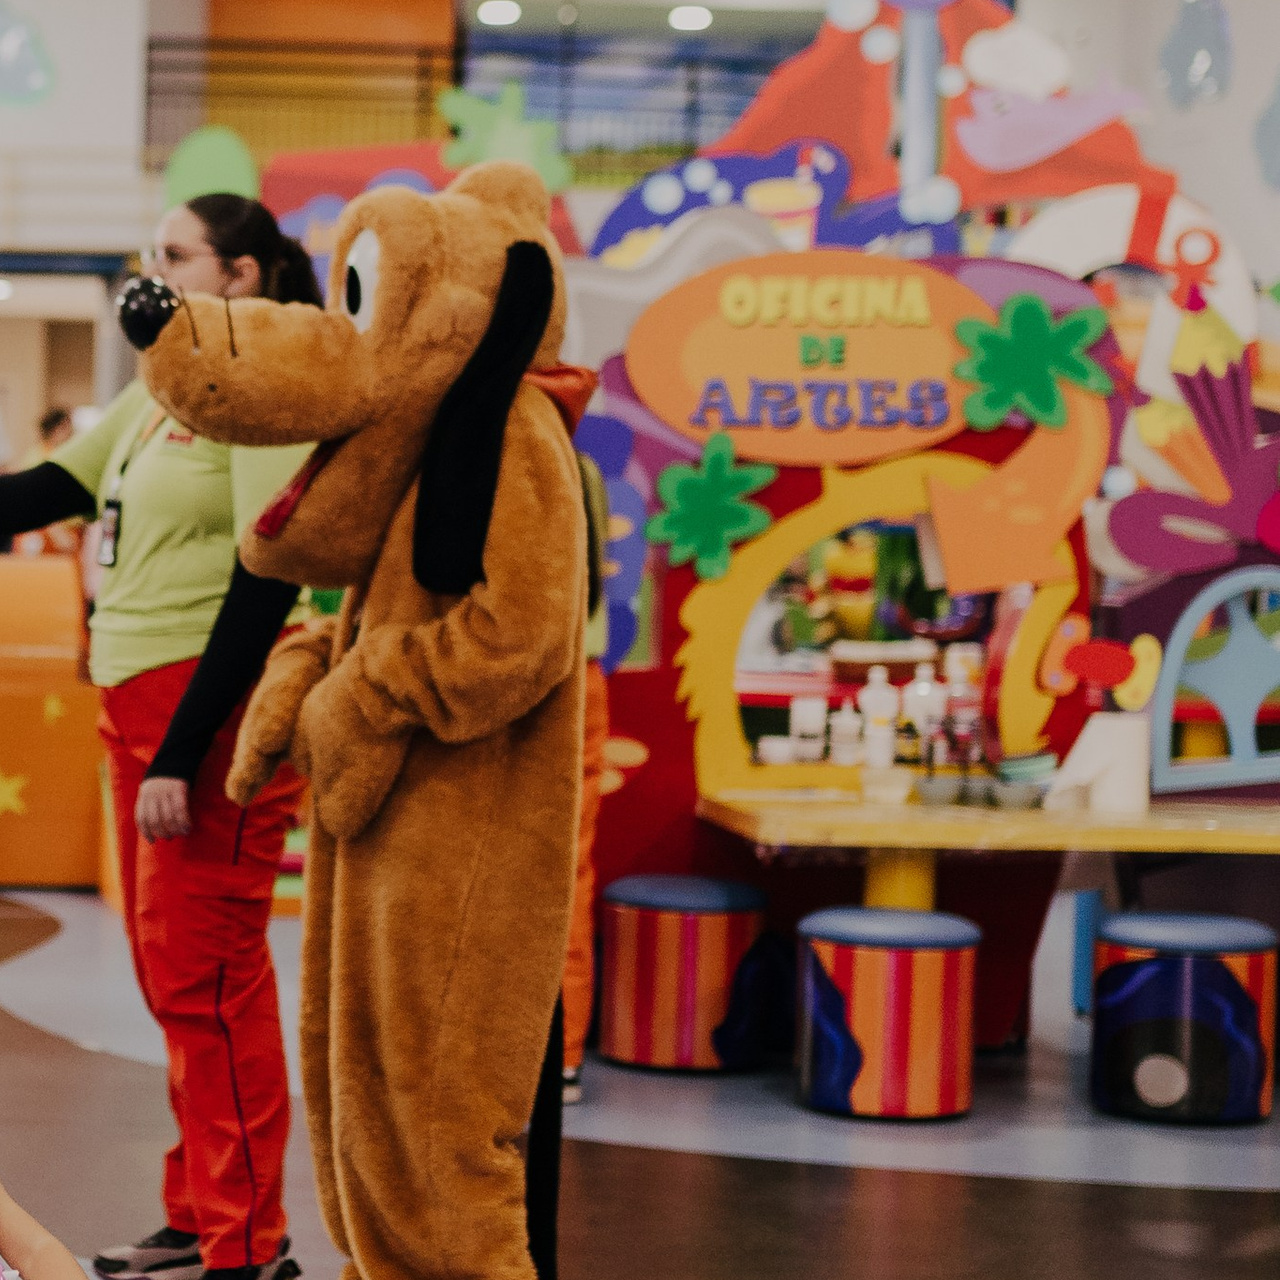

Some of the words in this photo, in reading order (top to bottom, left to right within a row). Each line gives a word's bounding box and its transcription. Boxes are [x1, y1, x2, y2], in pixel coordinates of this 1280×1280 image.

[722, 275, 930, 327] OFICINA
[799, 334, 846, 368] DE
[690, 376, 949, 430] ARTES
